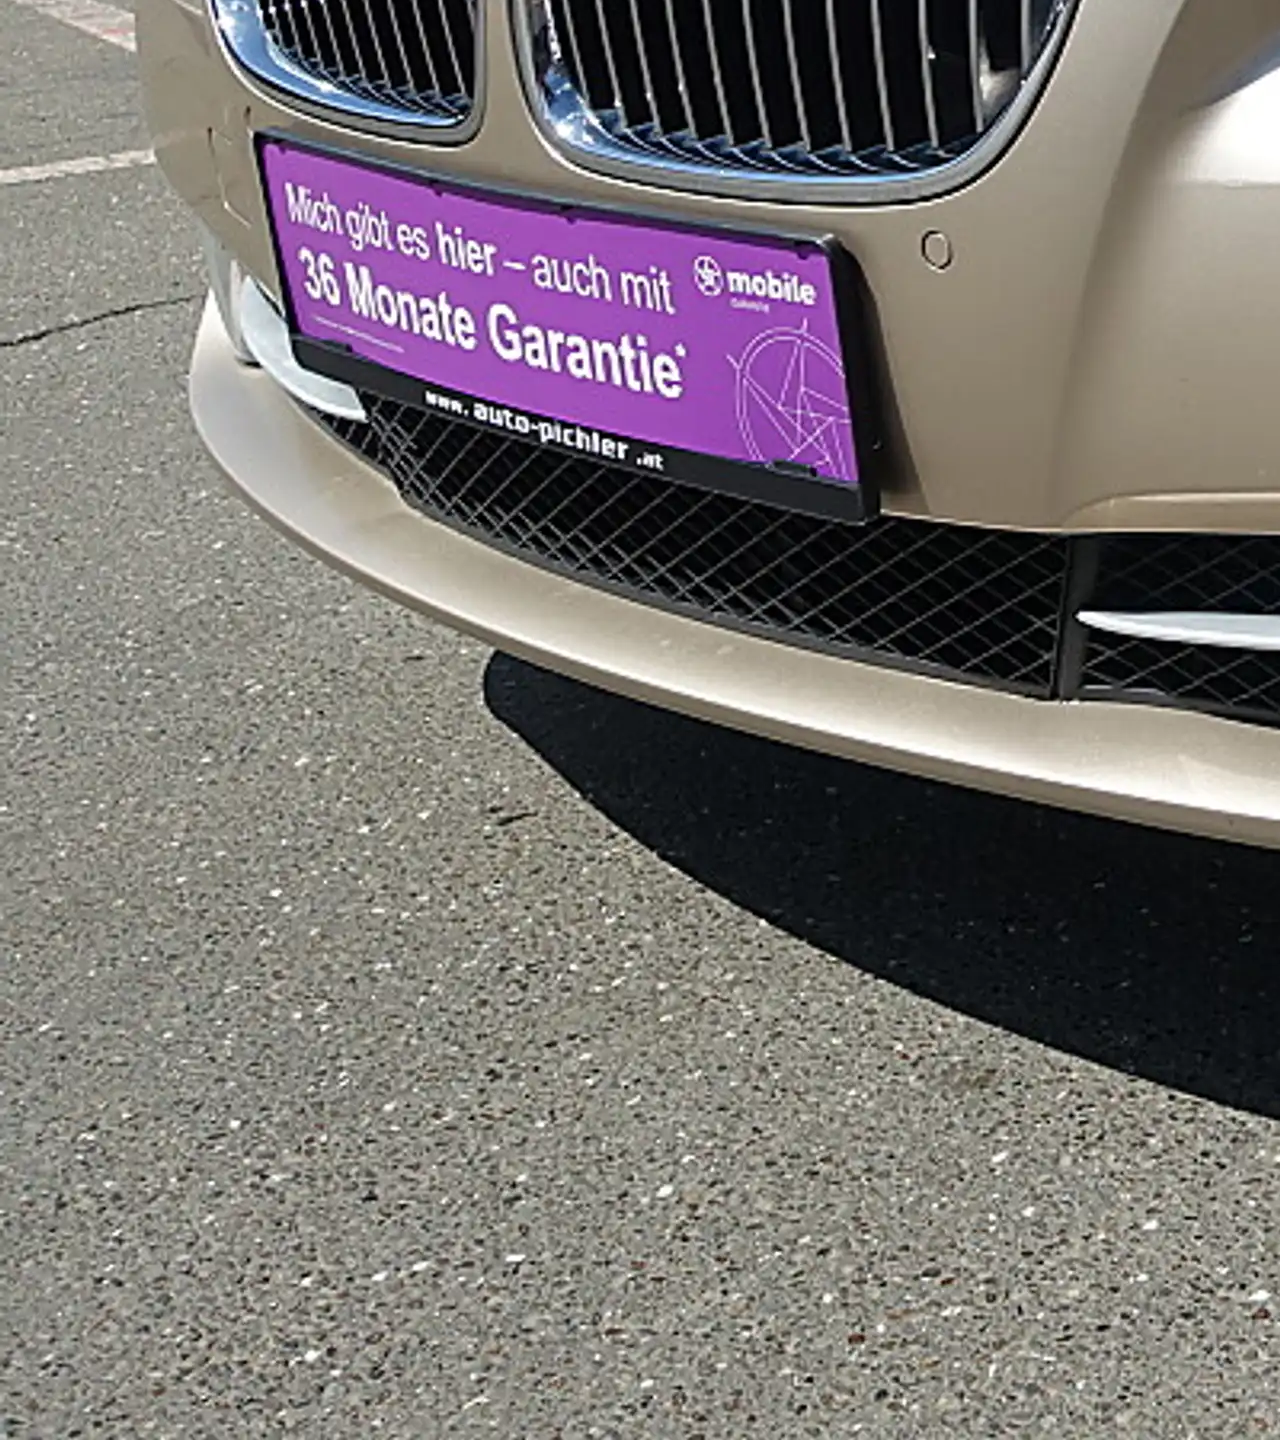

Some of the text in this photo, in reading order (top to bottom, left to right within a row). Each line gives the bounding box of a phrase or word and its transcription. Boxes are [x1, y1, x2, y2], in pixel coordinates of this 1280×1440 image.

[285, 182, 344, 235] Mich
[345, 201, 394, 251] gibt
[397, 223, 430, 260] es
[435, 221, 497, 277] hier
[531, 253, 612, 302] auch
[620, 265, 676, 315] mit
[298, 247, 341, 306] 36
[343, 262, 478, 350] Monate
[726, 269, 817, 306] mobile
